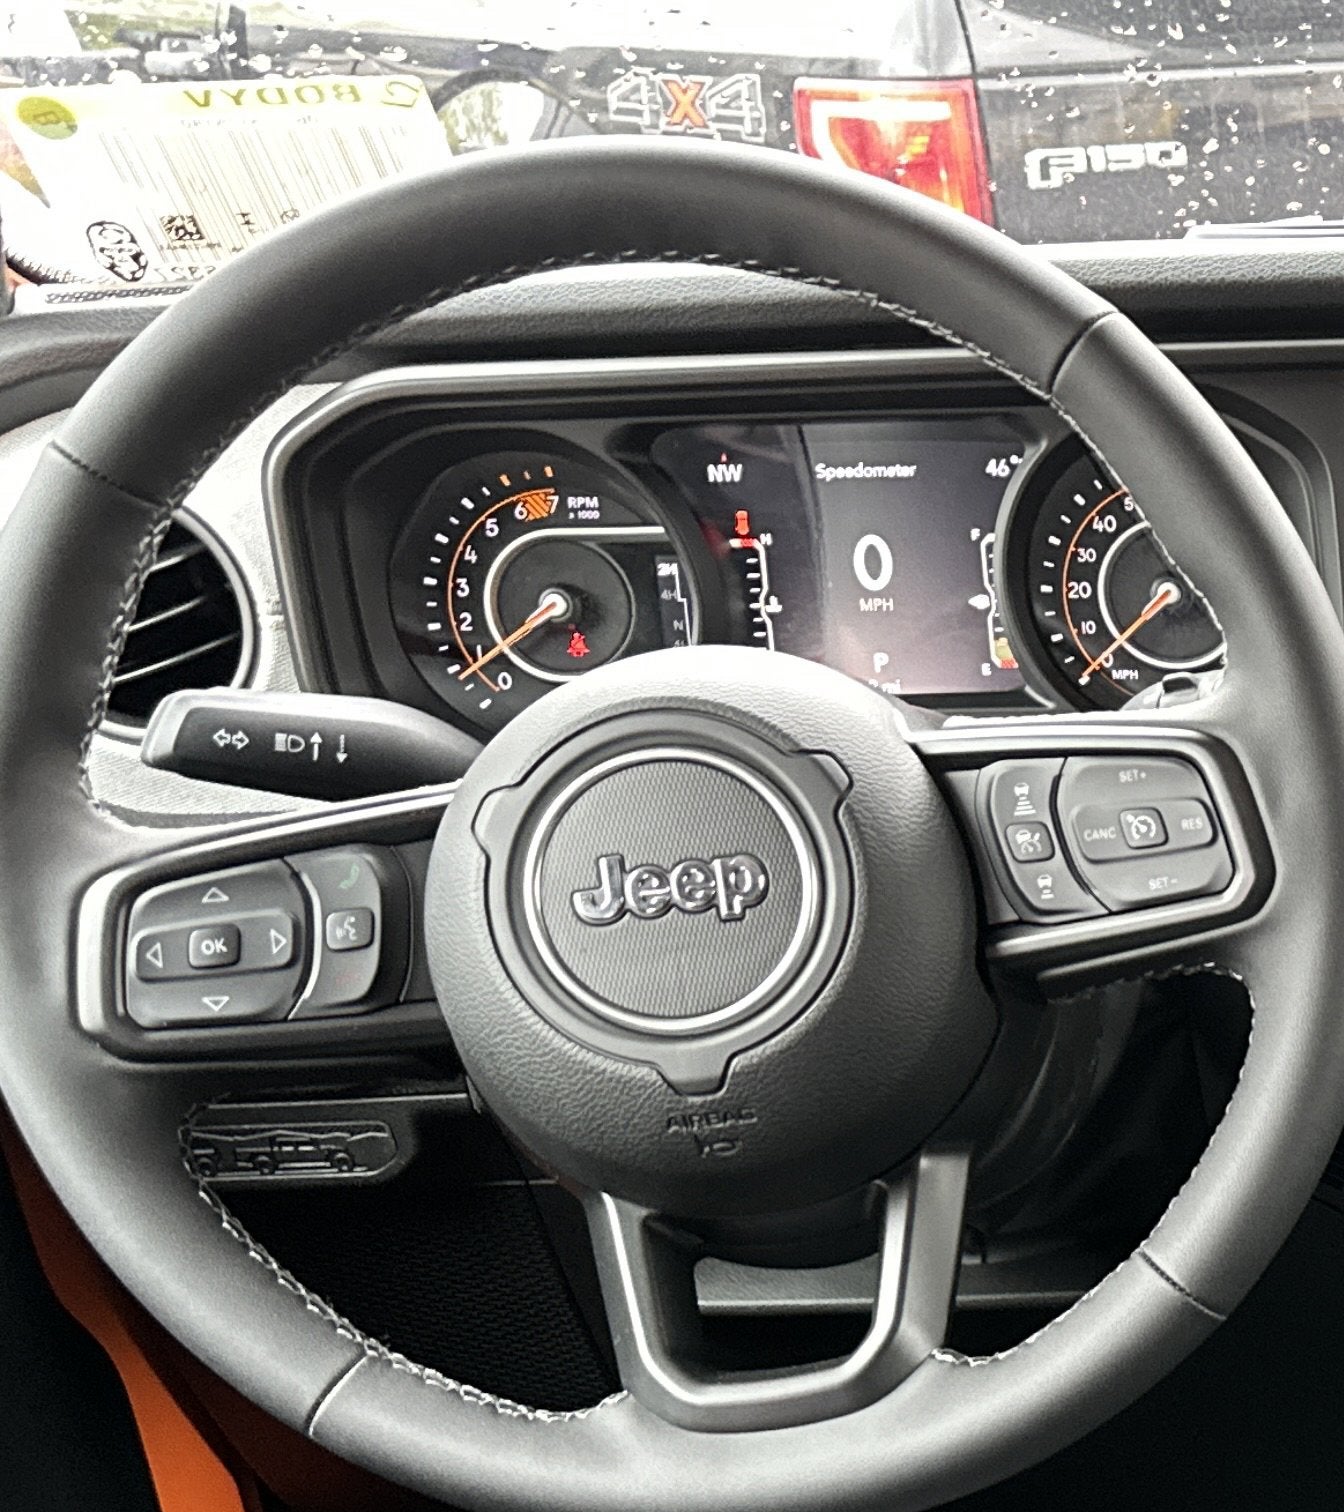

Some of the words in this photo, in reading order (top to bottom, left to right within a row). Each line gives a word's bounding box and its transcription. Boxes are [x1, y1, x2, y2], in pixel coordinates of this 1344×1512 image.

[707, 464, 743, 482] NW
[815, 462, 917, 481] Speedometer
[514, 501, 527, 521] 6
[548, 495, 559, 515] 7
[567, 496, 600, 509] RPM
[1123, 496, 1135, 512] 5
[577, 510, 600, 520] 1000
[484, 519, 500, 538] 5
[1092, 514, 1117, 534] 40
[761, 534, 773, 545] H
[970, 529, 981, 542] F
[464, 546, 478, 565] 4
[853, 534, 894, 591] 0
[1077, 548, 1097, 563] 30
[456, 578, 470, 597] 3
[1068, 582, 1092, 599] 20
[859, 598, 894, 612] MPH
[459, 612, 474, 631] 2
[673, 619, 684, 631] N
[1081, 621, 1096, 636] 10
[873, 652, 889, 673] P
[981, 662, 992, 677] E
[497, 672, 513, 691] 0
[1111, 669, 1139, 680] MPH
[1180, 816, 1204, 832] RES
[1083, 826, 1116, 842] CANC
[571, 852, 771, 926] Jeep
[201, 938, 228, 957] OK
[665, 1107, 758, 1135] AIRBAG
